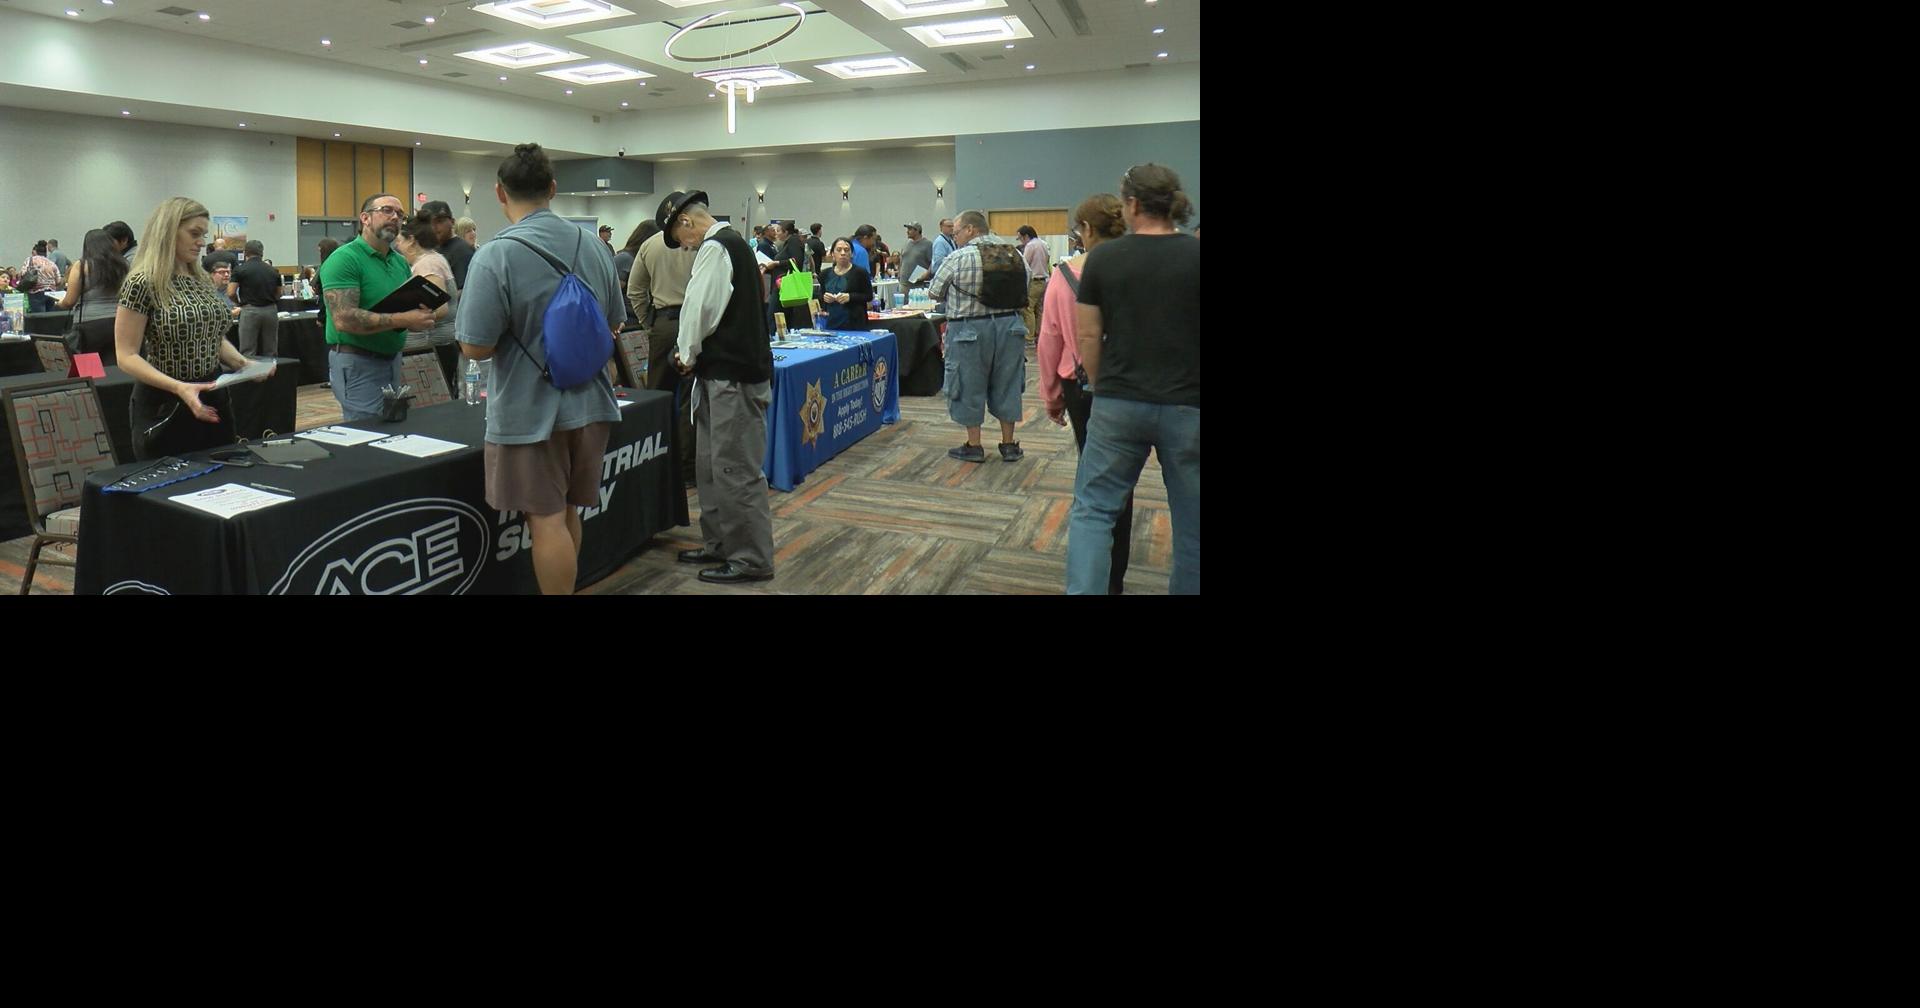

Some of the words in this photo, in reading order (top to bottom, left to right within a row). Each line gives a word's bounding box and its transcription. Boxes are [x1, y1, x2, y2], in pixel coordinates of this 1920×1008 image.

[833, 372, 839, 388] A
[838, 404, 850, 417] Apply
[850, 395, 863, 410] Today!
[315, 516, 464, 595] ACE
